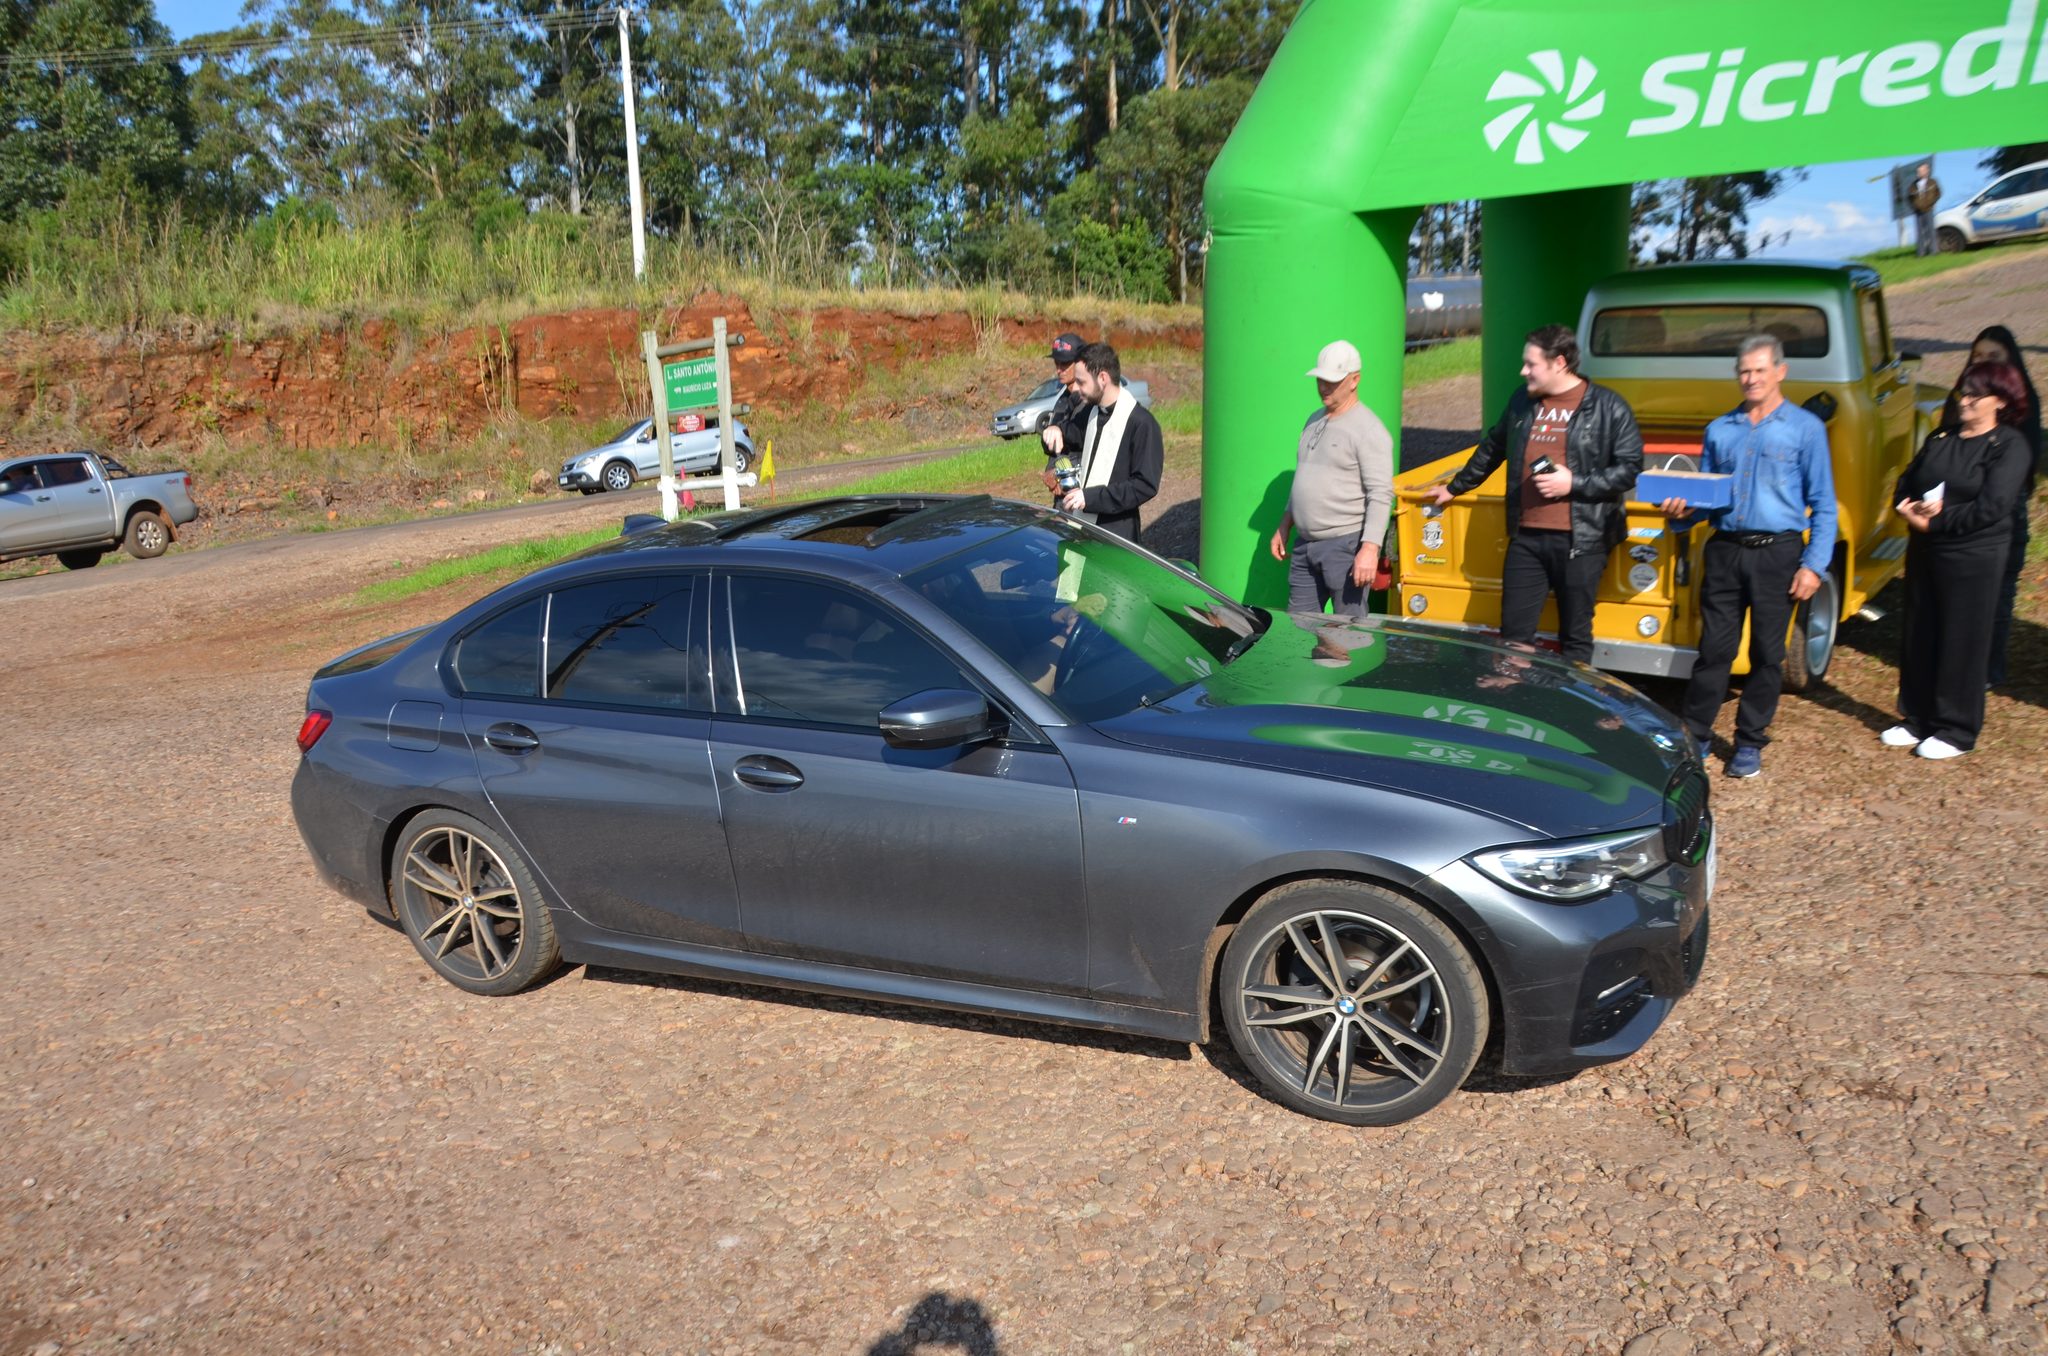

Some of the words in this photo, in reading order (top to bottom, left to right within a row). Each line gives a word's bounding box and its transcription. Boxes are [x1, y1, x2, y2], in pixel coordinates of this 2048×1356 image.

[673, 365, 692, 379] SANTO
[693, 360, 716, 376] ANTÔNI
[1535, 407, 1574, 423] LAN
